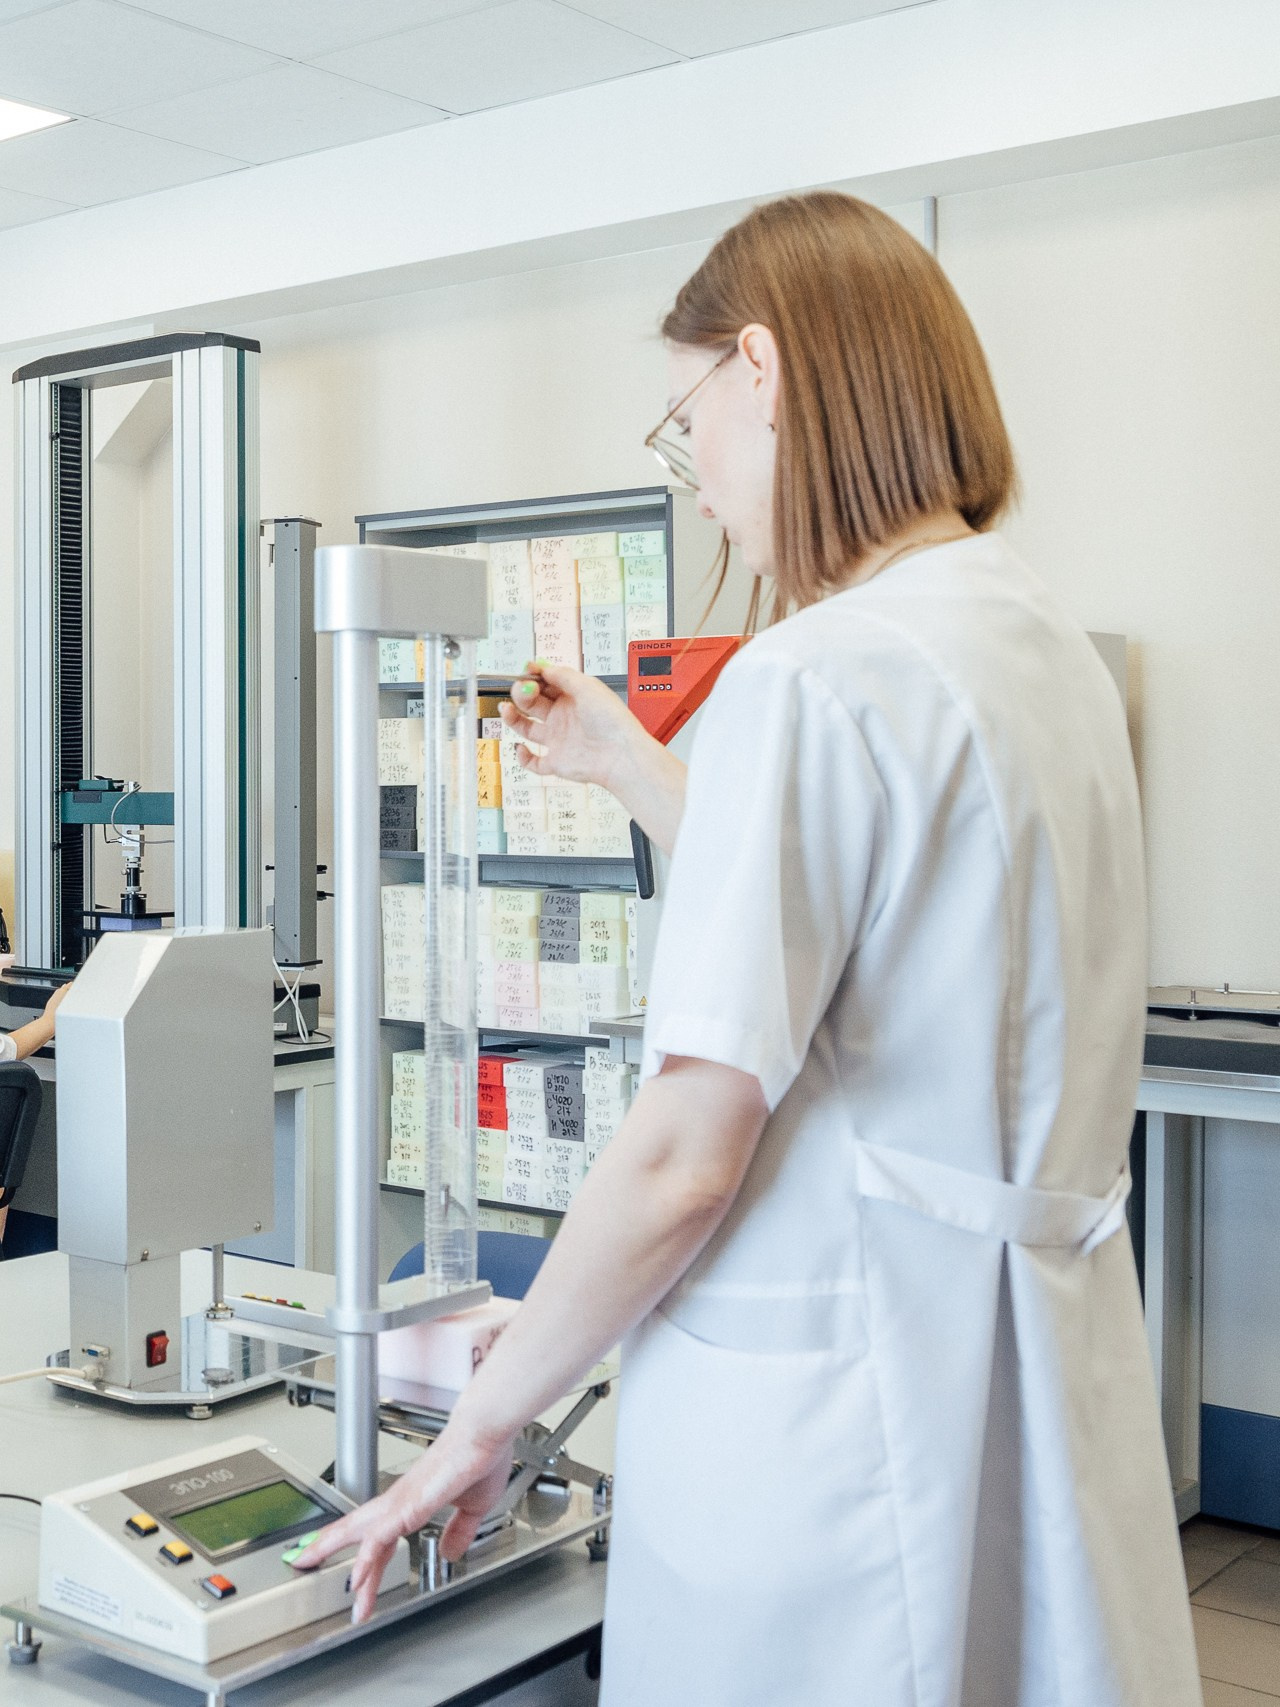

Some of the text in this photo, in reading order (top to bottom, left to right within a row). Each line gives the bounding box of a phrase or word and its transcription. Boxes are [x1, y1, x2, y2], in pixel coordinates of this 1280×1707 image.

[637, 641, 672, 650] BINDER
[546, 1095, 574, 1110] C 4020
[559, 1118, 580, 1129] 4020
